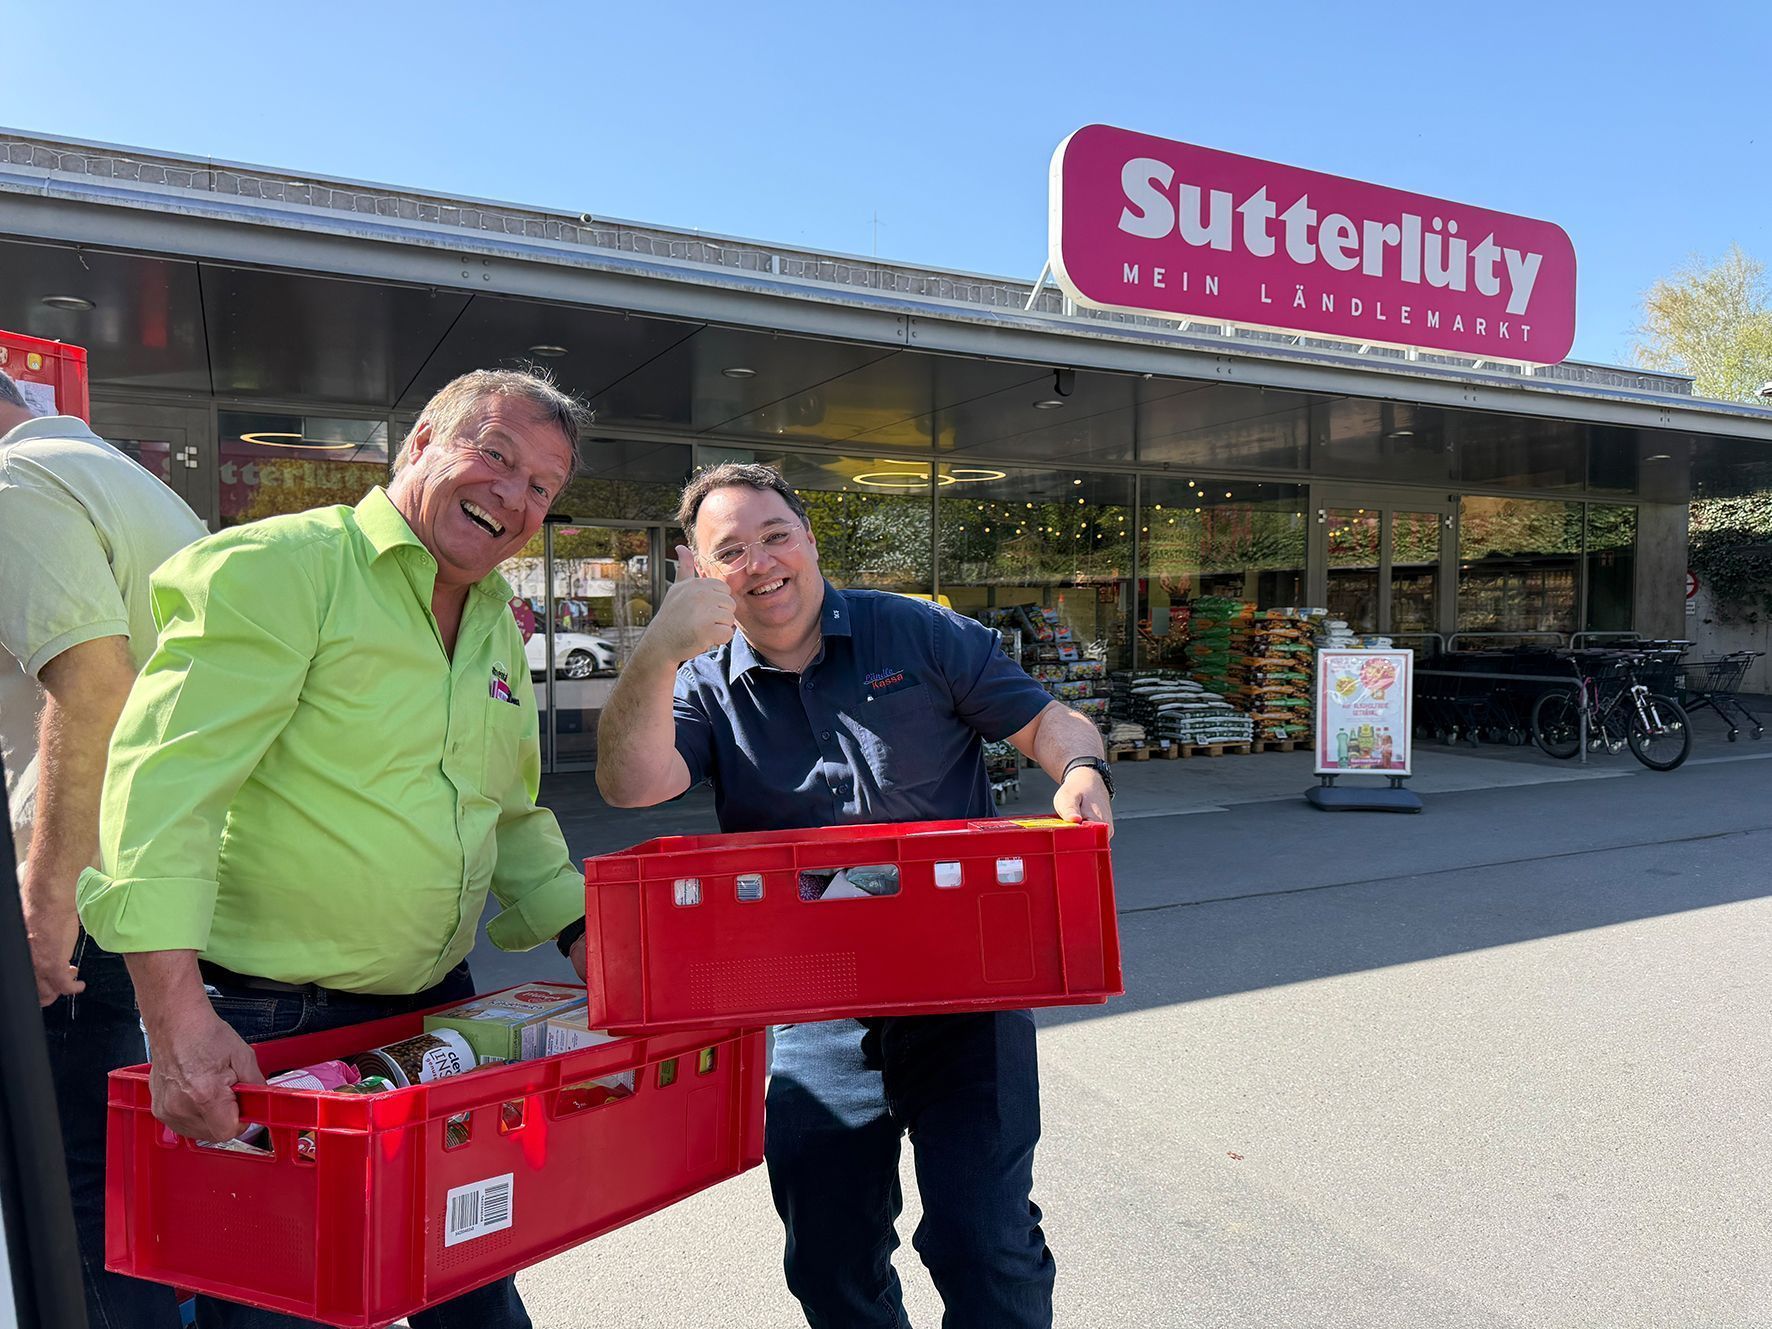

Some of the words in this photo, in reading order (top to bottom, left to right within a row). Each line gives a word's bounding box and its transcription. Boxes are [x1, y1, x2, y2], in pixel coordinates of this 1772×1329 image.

[1118, 157, 1543, 316] Sutterlüty
[1123, 262, 1219, 297] MEIN
[1260, 283, 1533, 343] LÄNDLEMARKT
[872, 674, 904, 689] Kassa
